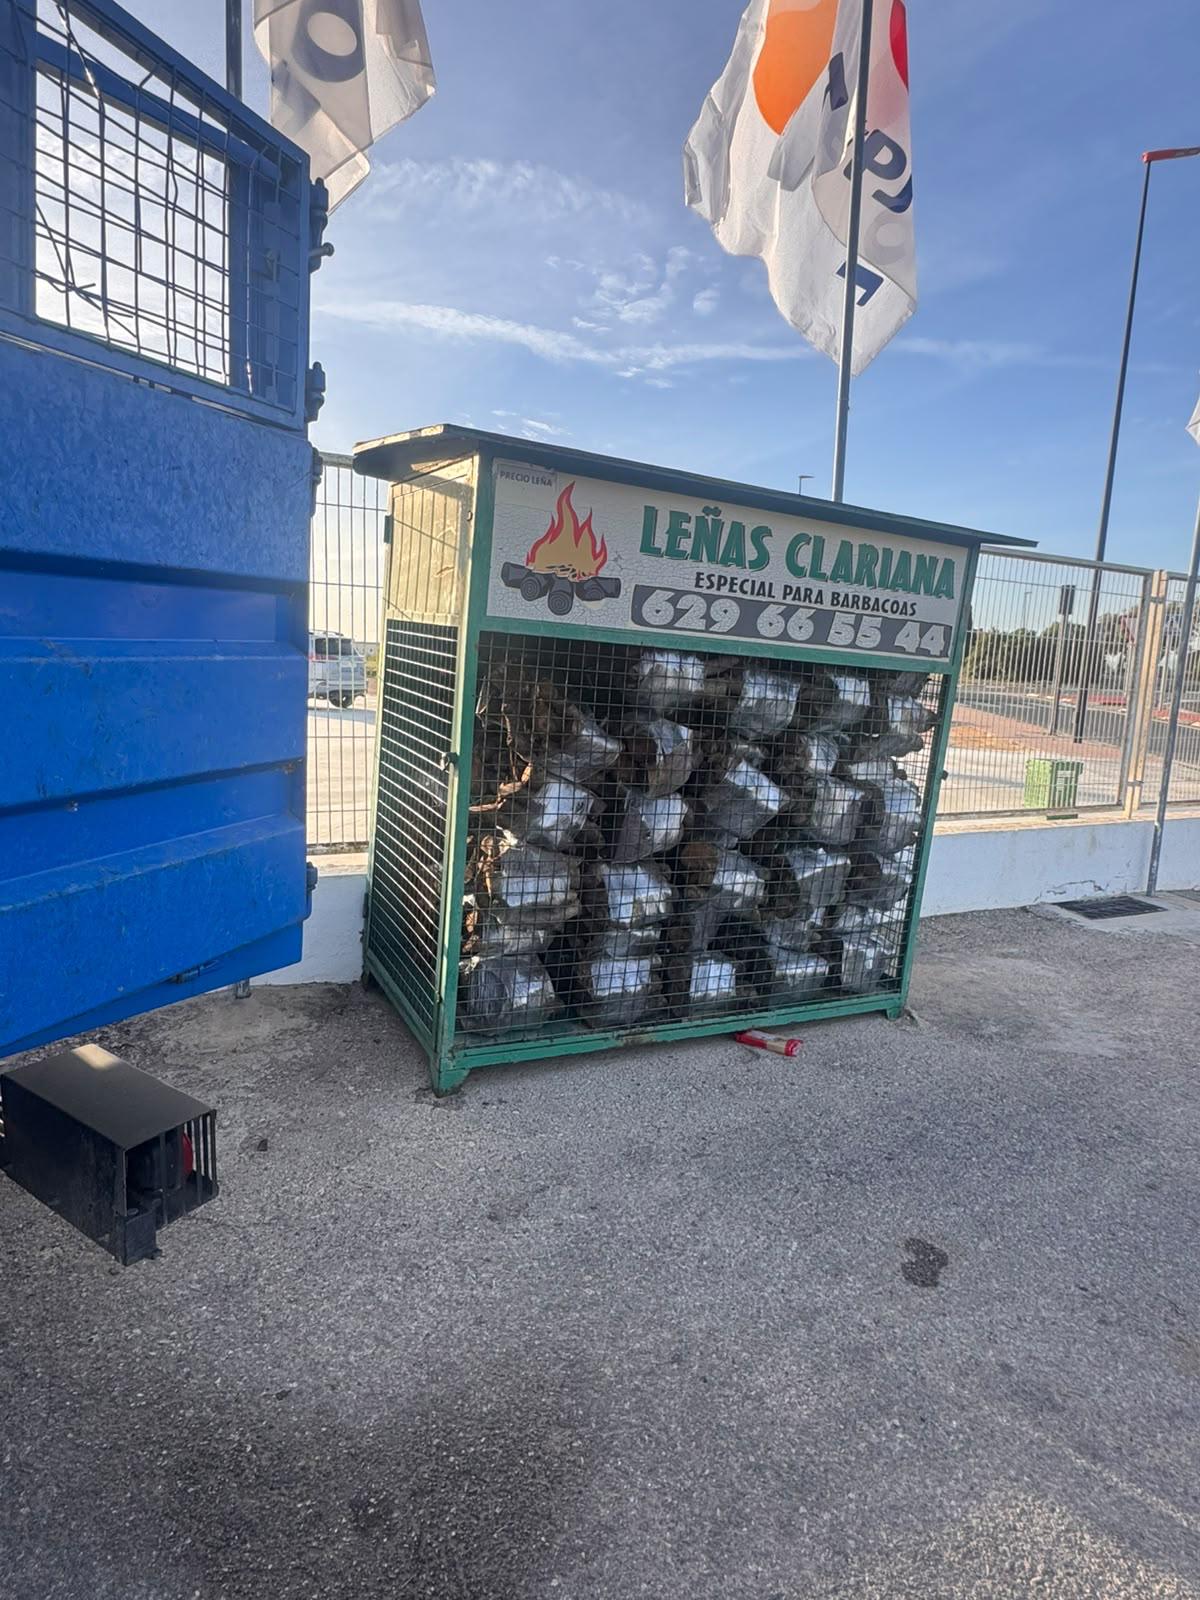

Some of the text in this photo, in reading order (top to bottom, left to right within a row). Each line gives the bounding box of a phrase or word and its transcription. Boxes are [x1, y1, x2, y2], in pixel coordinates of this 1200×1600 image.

[500, 470, 553, 487] PRECIO LEÑA
[639, 505, 955, 599] LEÑAS CLARIANA
[694, 571, 917, 617] ESPECIAL PARA BARBACOAS
[641, 589, 945, 657] 629 66 55 44
